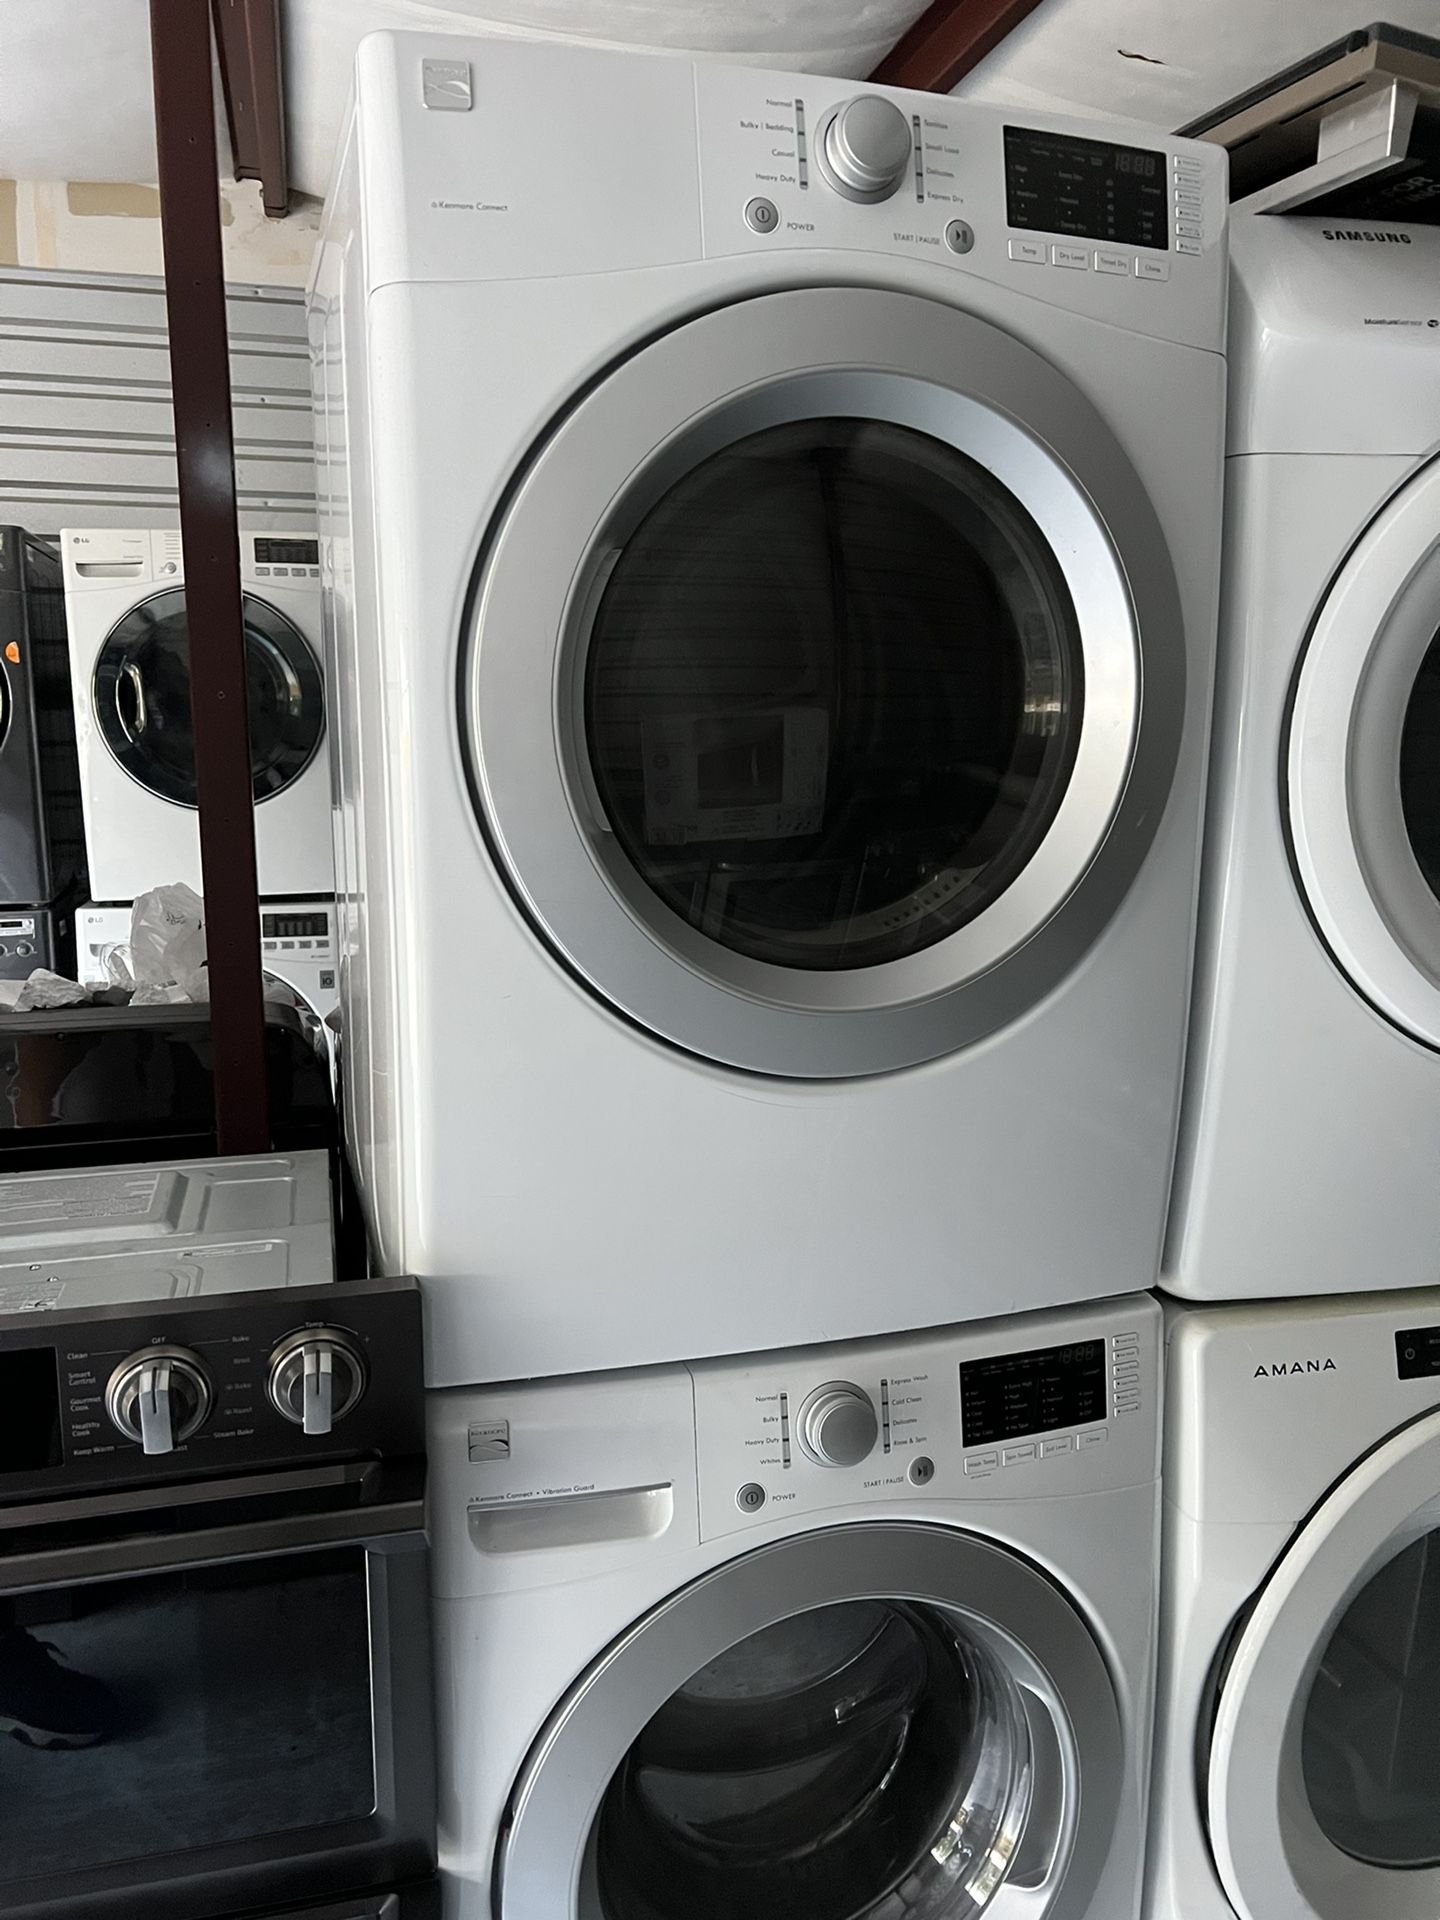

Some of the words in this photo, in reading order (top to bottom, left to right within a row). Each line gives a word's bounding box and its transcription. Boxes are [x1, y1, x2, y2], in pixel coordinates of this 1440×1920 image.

[756, 173, 778, 184] Heavy
[780, 175, 796, 184] Duty
[439, 202, 474, 210] Kenmore
[476, 203, 508, 211] Connect
[787, 222, 815, 232] POWER
[893, 233, 914, 242] START
[918, 236, 941, 245] PAUSE
[1322, 230, 1412, 244] SAMSUNG
[1253, 1358, 1337, 1378] AMANA
[755, 1394, 778, 1402] Normal
[763, 1416, 779, 1424] Bulky
[745, 1437, 764, 1446] Heavy
[766, 1436, 780, 1445] Duty
[863, 1479, 881, 1488] START
[886, 1476, 904, 1485] PAUSE
[475, 1494, 505, 1503] Kenmore
[506, 1491, 533, 1500] Connect
[542, 1486, 572, 1496] Vibration
[573, 1483, 595, 1492] Guard
[772, 1493, 796, 1501] POWER
